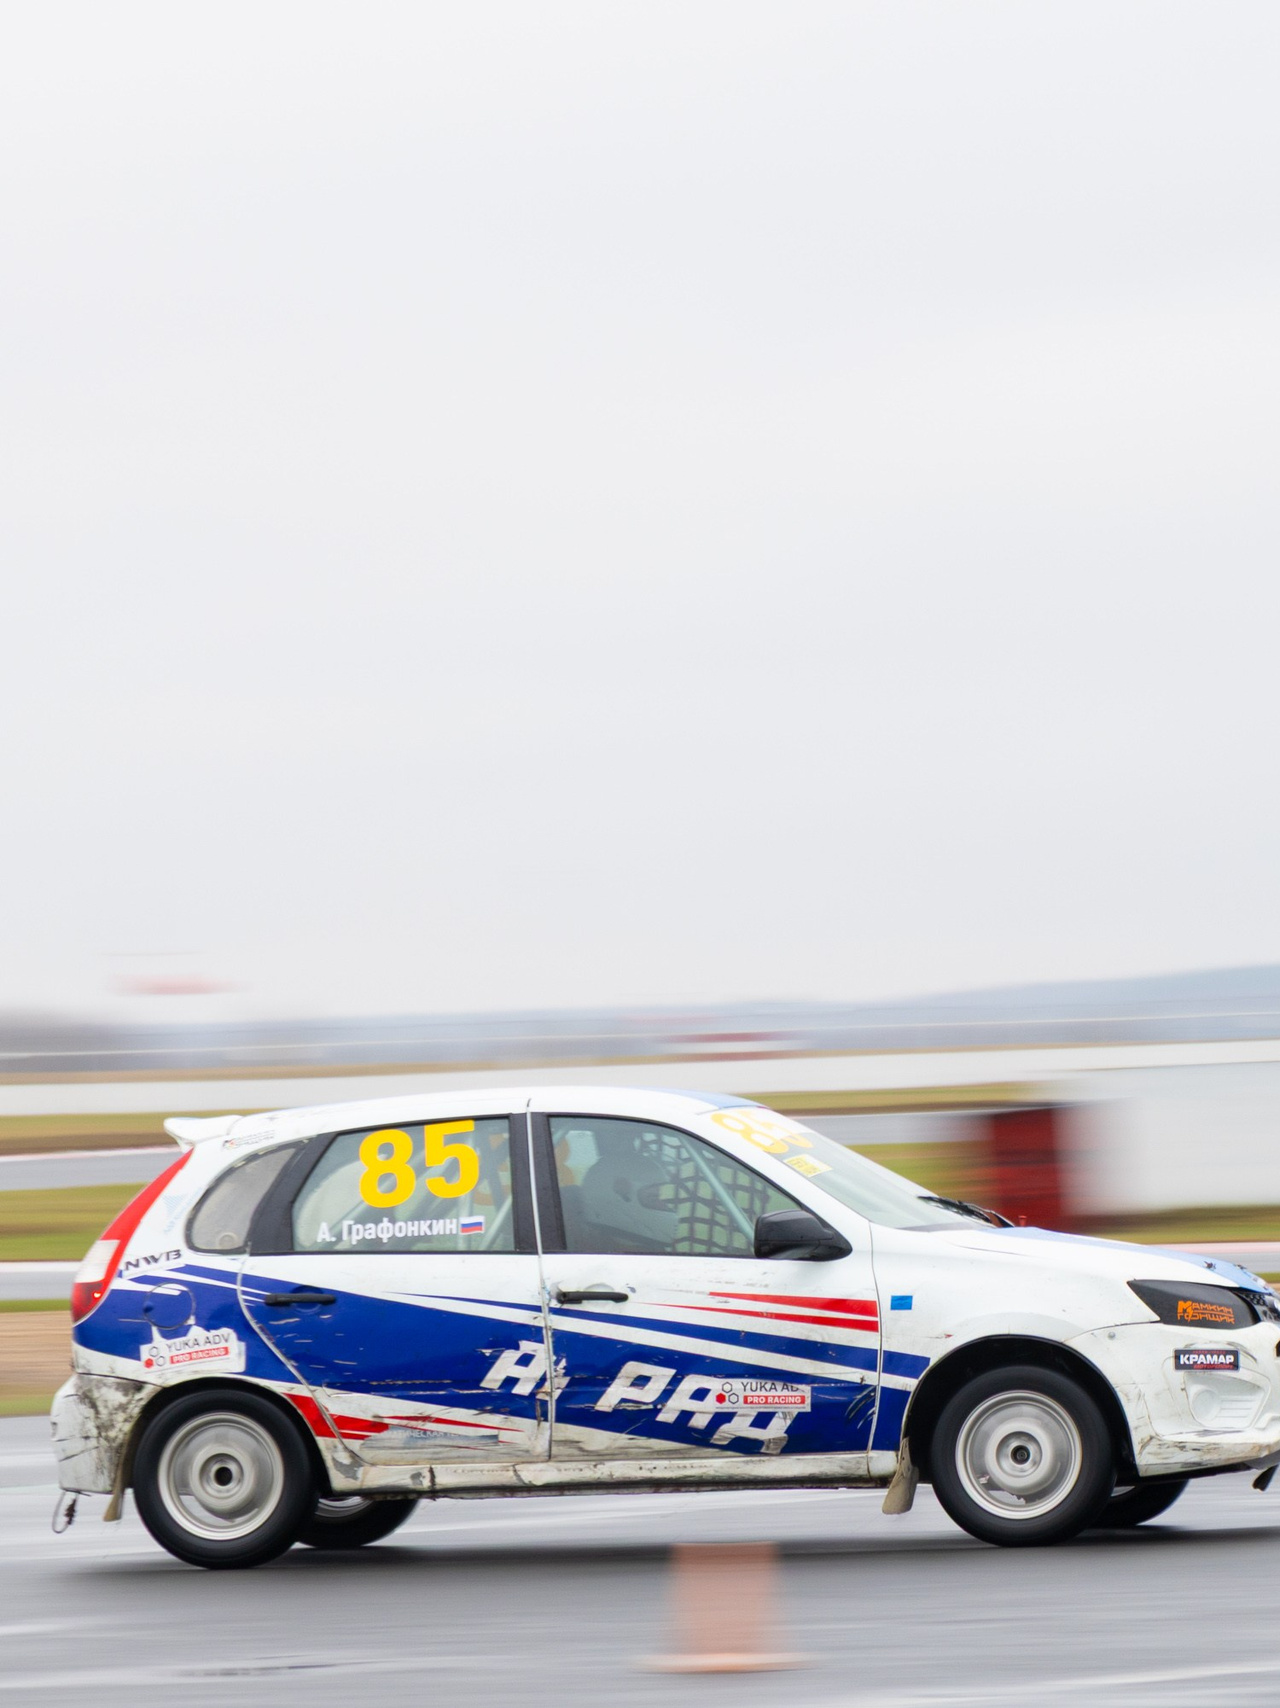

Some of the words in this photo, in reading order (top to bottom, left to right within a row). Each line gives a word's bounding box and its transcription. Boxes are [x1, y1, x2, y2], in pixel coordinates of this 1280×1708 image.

[359, 1119, 480, 1209] 85
[316, 1222, 337, 1242] А.
[342, 1217, 457, 1245] Графонкин
[166, 1339, 201, 1353] YUKA
[203, 1333, 231, 1346] ADV
[173, 1353, 191, 1363] PRO
[192, 1346, 226, 1359] RACING
[1180, 1354, 1235, 1365] КРАМАР
[741, 1381, 778, 1393] YUKA
[780, 1382, 805, 1393] AD
[747, 1395, 765, 1404] PRO
[767, 1395, 802, 1404] RACING
